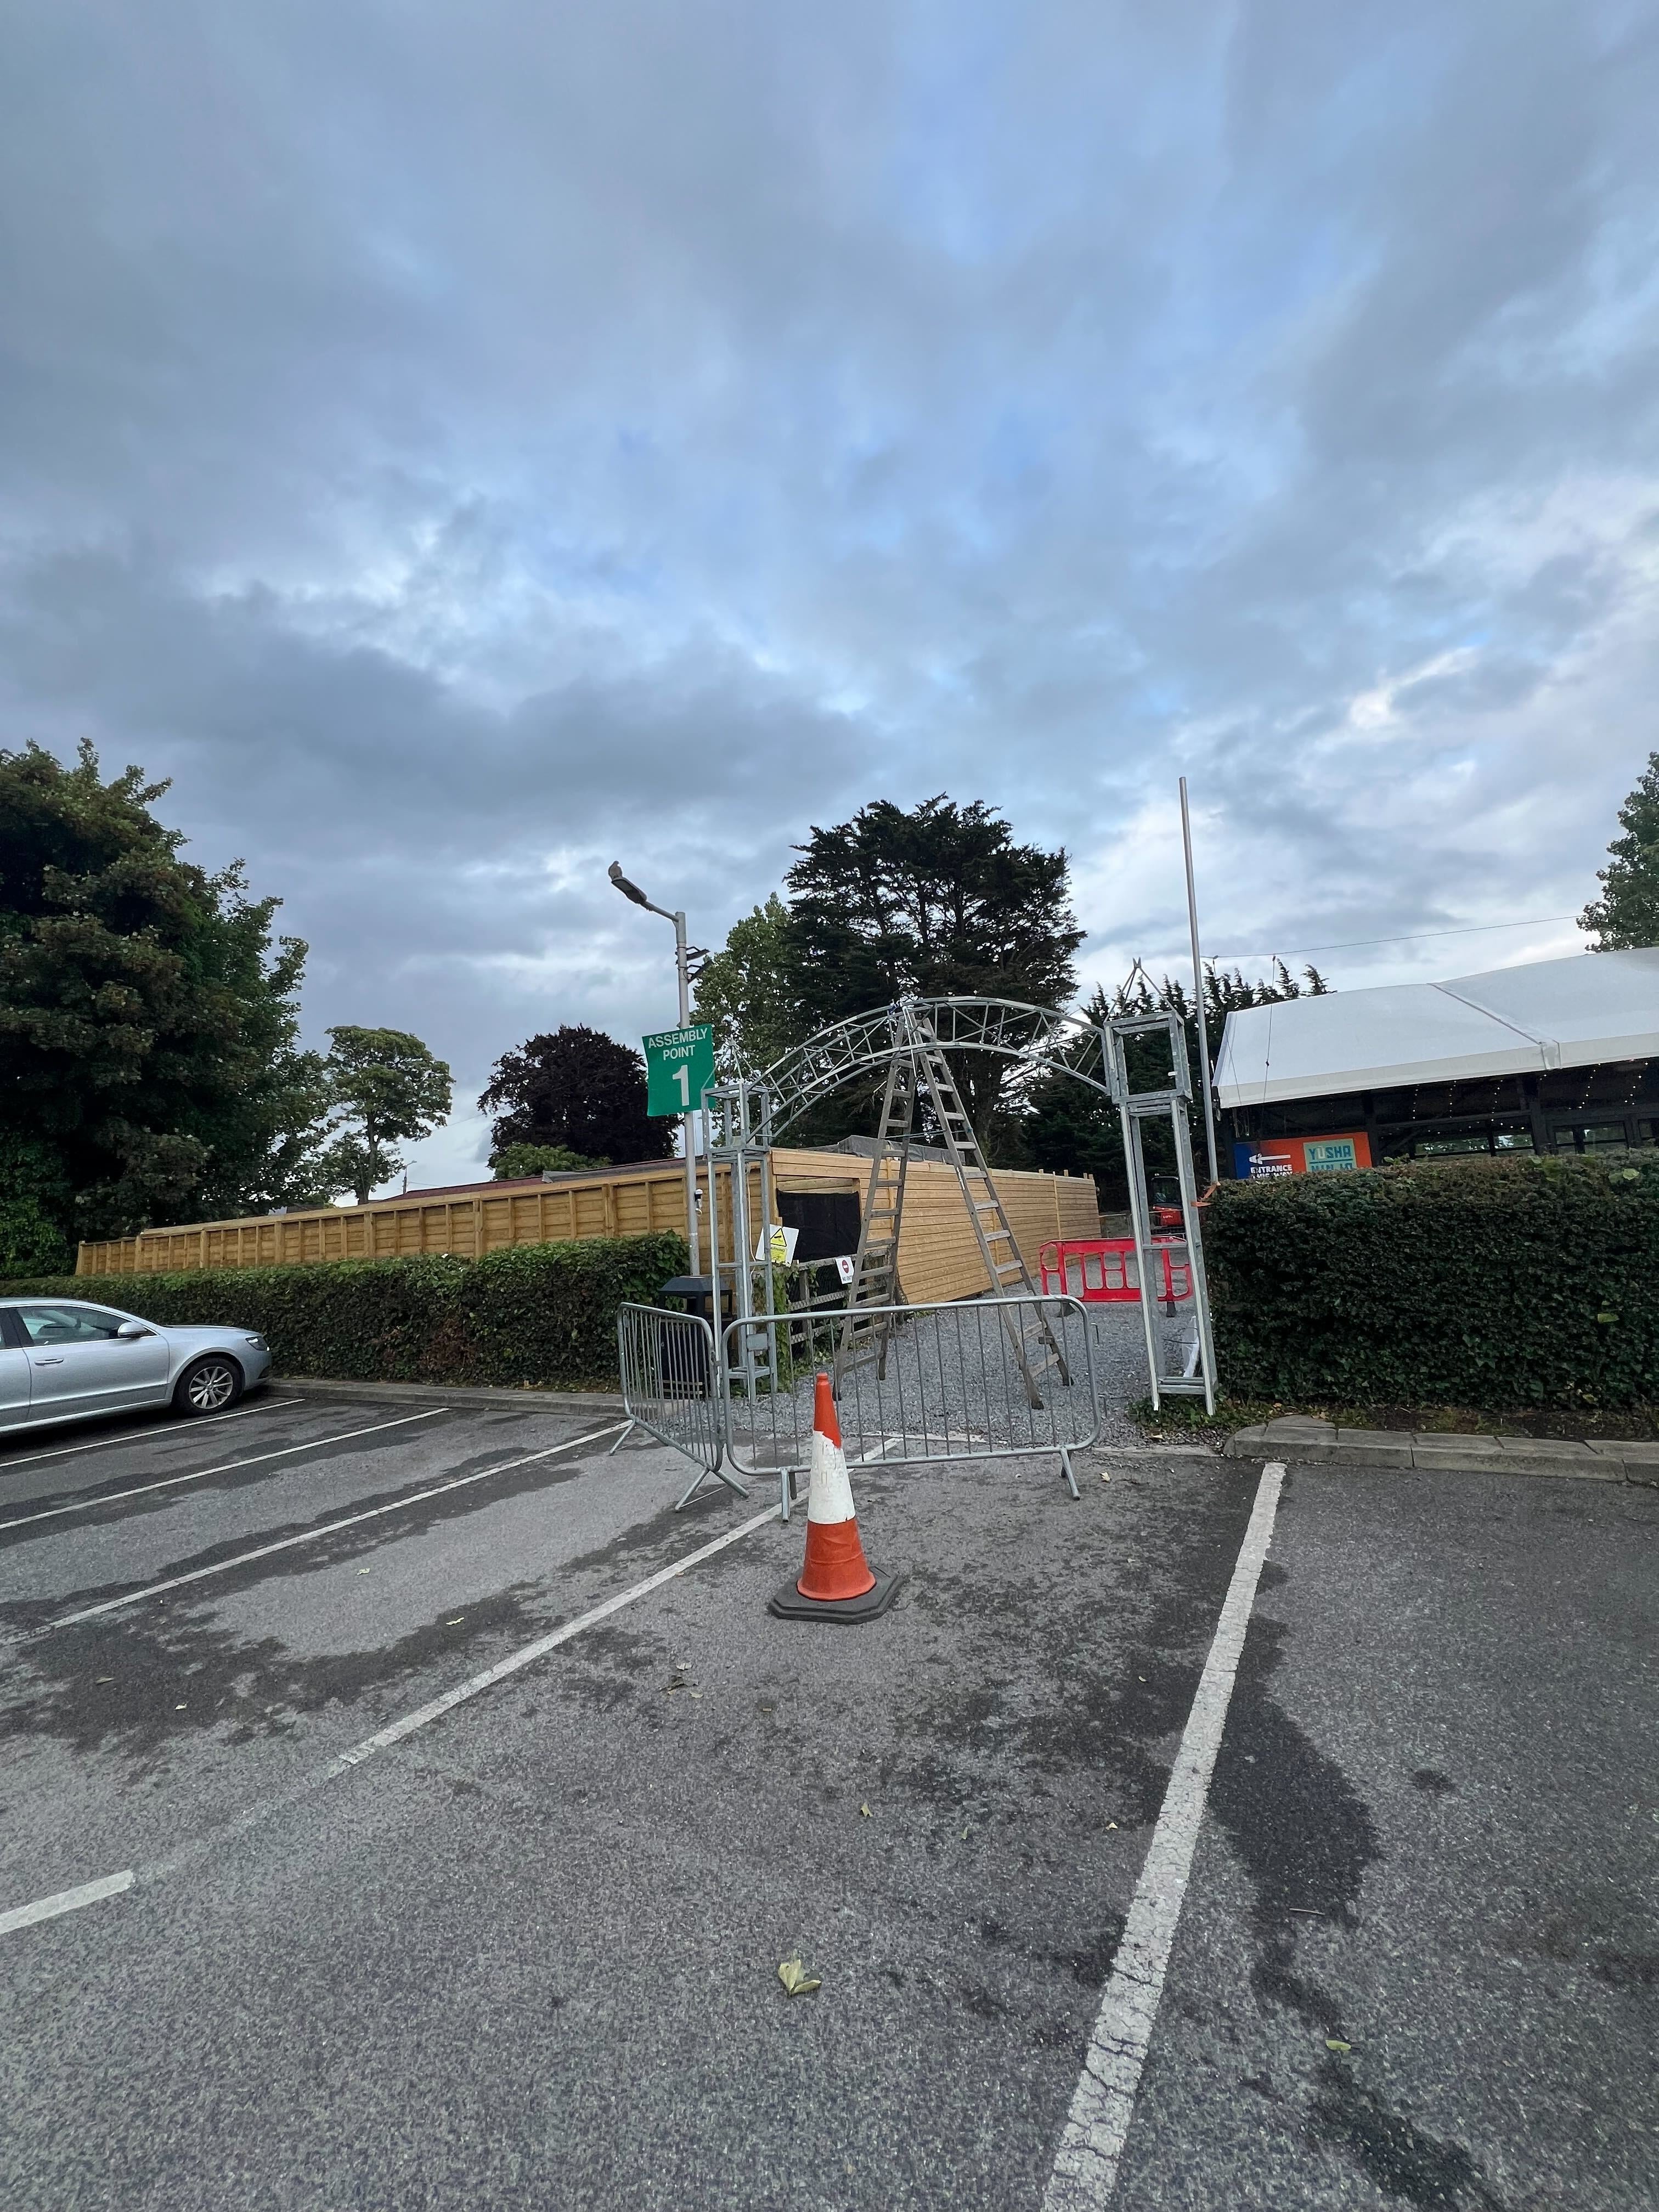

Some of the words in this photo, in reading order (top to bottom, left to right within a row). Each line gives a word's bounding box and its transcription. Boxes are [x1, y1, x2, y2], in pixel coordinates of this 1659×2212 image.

[648, 1028, 708, 1048] ASSEMBLY
[663, 1045, 695, 1060] POINT
[672, 1064, 690, 1107] 1
[1250, 1164, 1293, 1173] ENTRANCE
